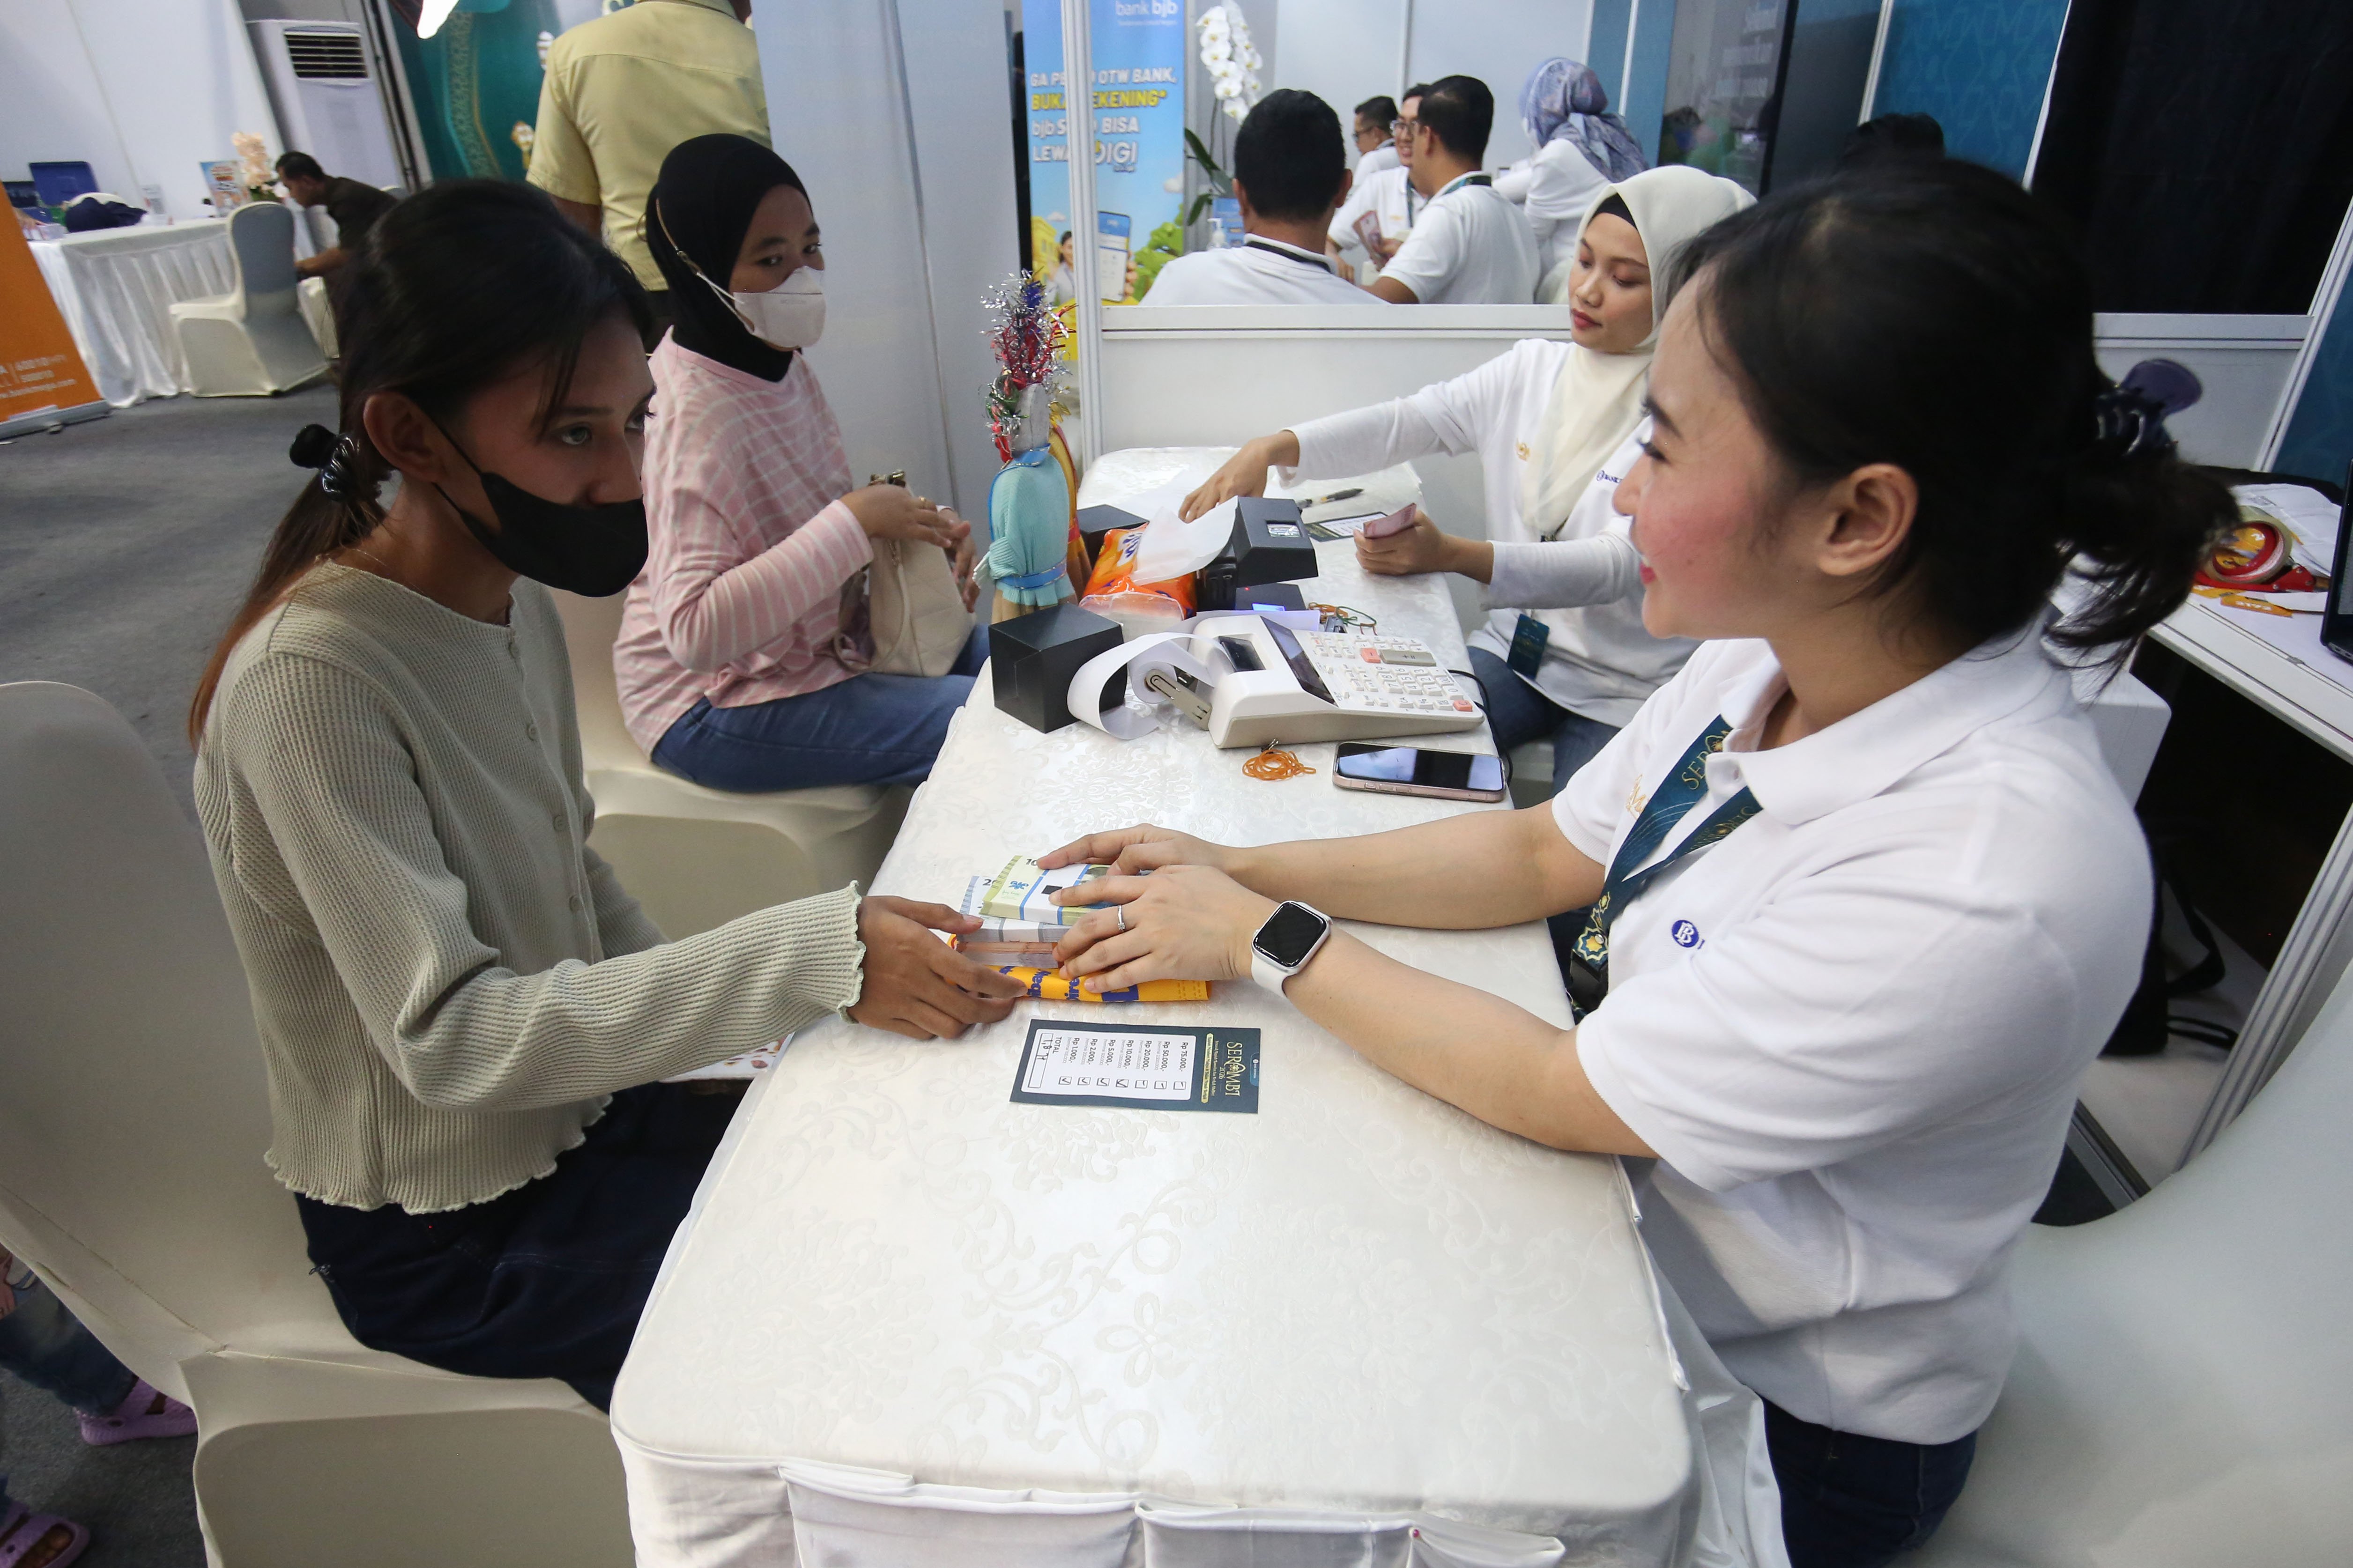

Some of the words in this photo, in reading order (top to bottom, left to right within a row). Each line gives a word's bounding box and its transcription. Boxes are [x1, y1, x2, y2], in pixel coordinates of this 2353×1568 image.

[1114, 0, 1148, 15] bank
[1151, 0, 1178, 18] bjb
[1098, 69, 1129, 85] OTW
[1132, 67, 1178, 83] BANK,
[1032, 119, 1055, 139] bjb
[1102, 116, 1140, 134] BISA
[1053, 1036, 1062, 1053] TOTAL
[1069, 1046, 1078, 1063] 1.000,-
[1087, 1047, 1096, 1065] 2.000,-
[1106, 1048, 1114, 1066] 5.000,-
[1123, 1049, 1133, 1069] 10.000,-
[1141, 1049, 1151, 1071] 20.000,-
[1160, 1050, 1169, 1072] 50.000,-
[1178, 1050, 1188, 1072] 75.000,-
